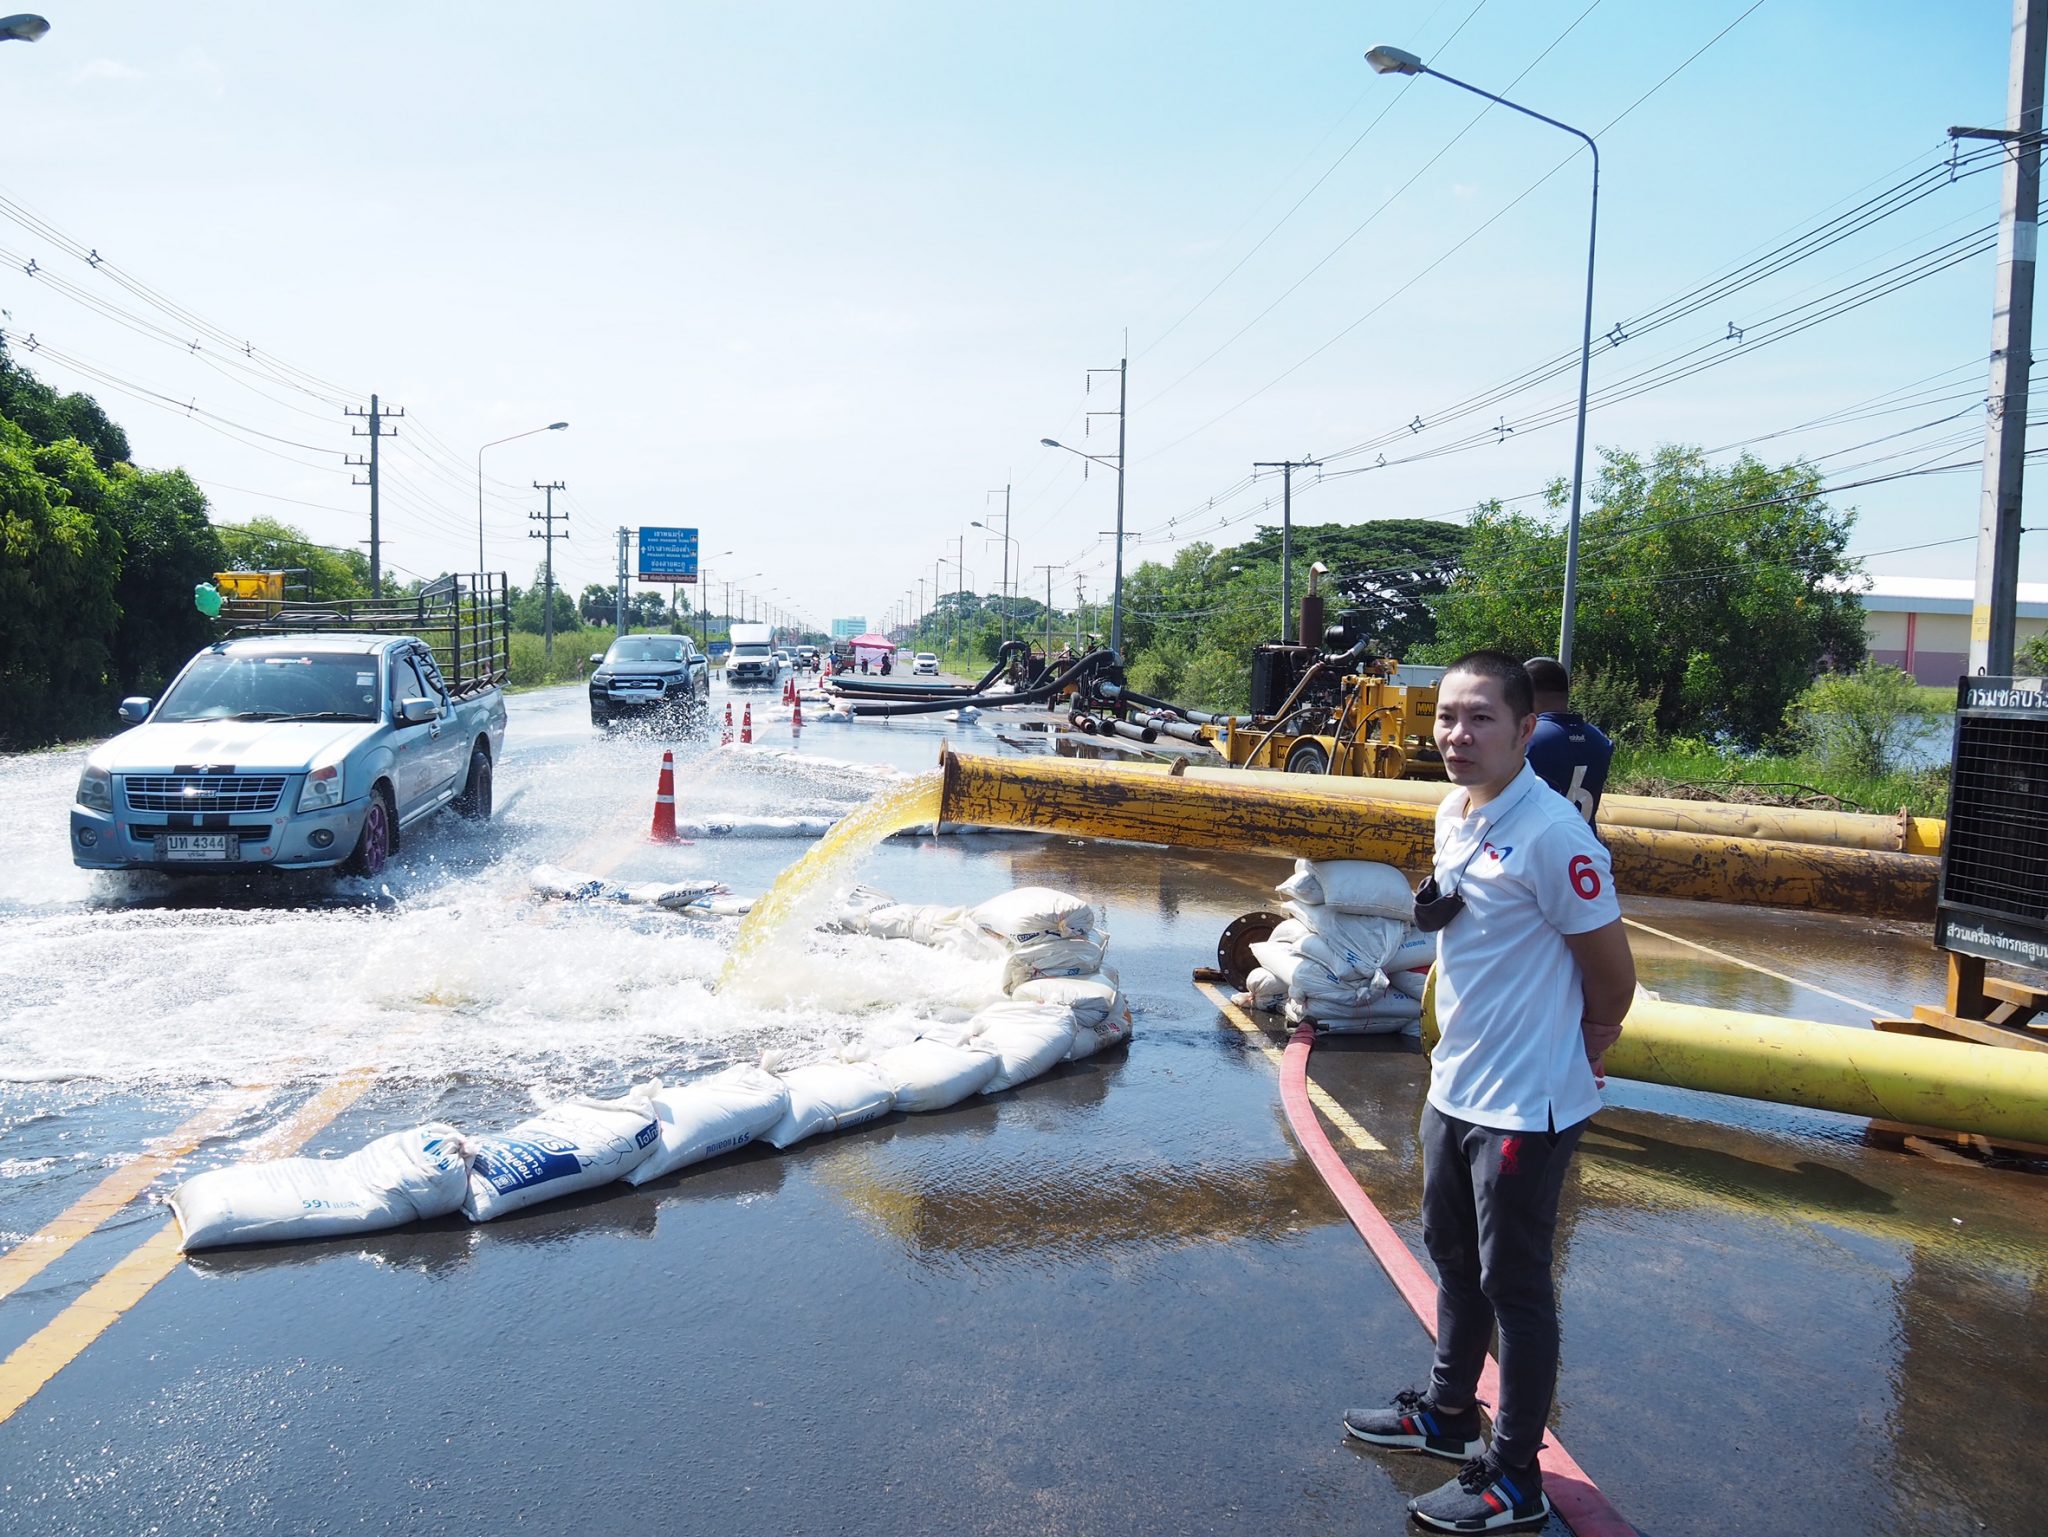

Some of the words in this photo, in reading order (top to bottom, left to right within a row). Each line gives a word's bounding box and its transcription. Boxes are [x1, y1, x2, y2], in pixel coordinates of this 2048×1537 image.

[193, 837, 225, 849] 4344
[1568, 854, 1601, 901] 6
[302, 1199, 332, 1209] 591
